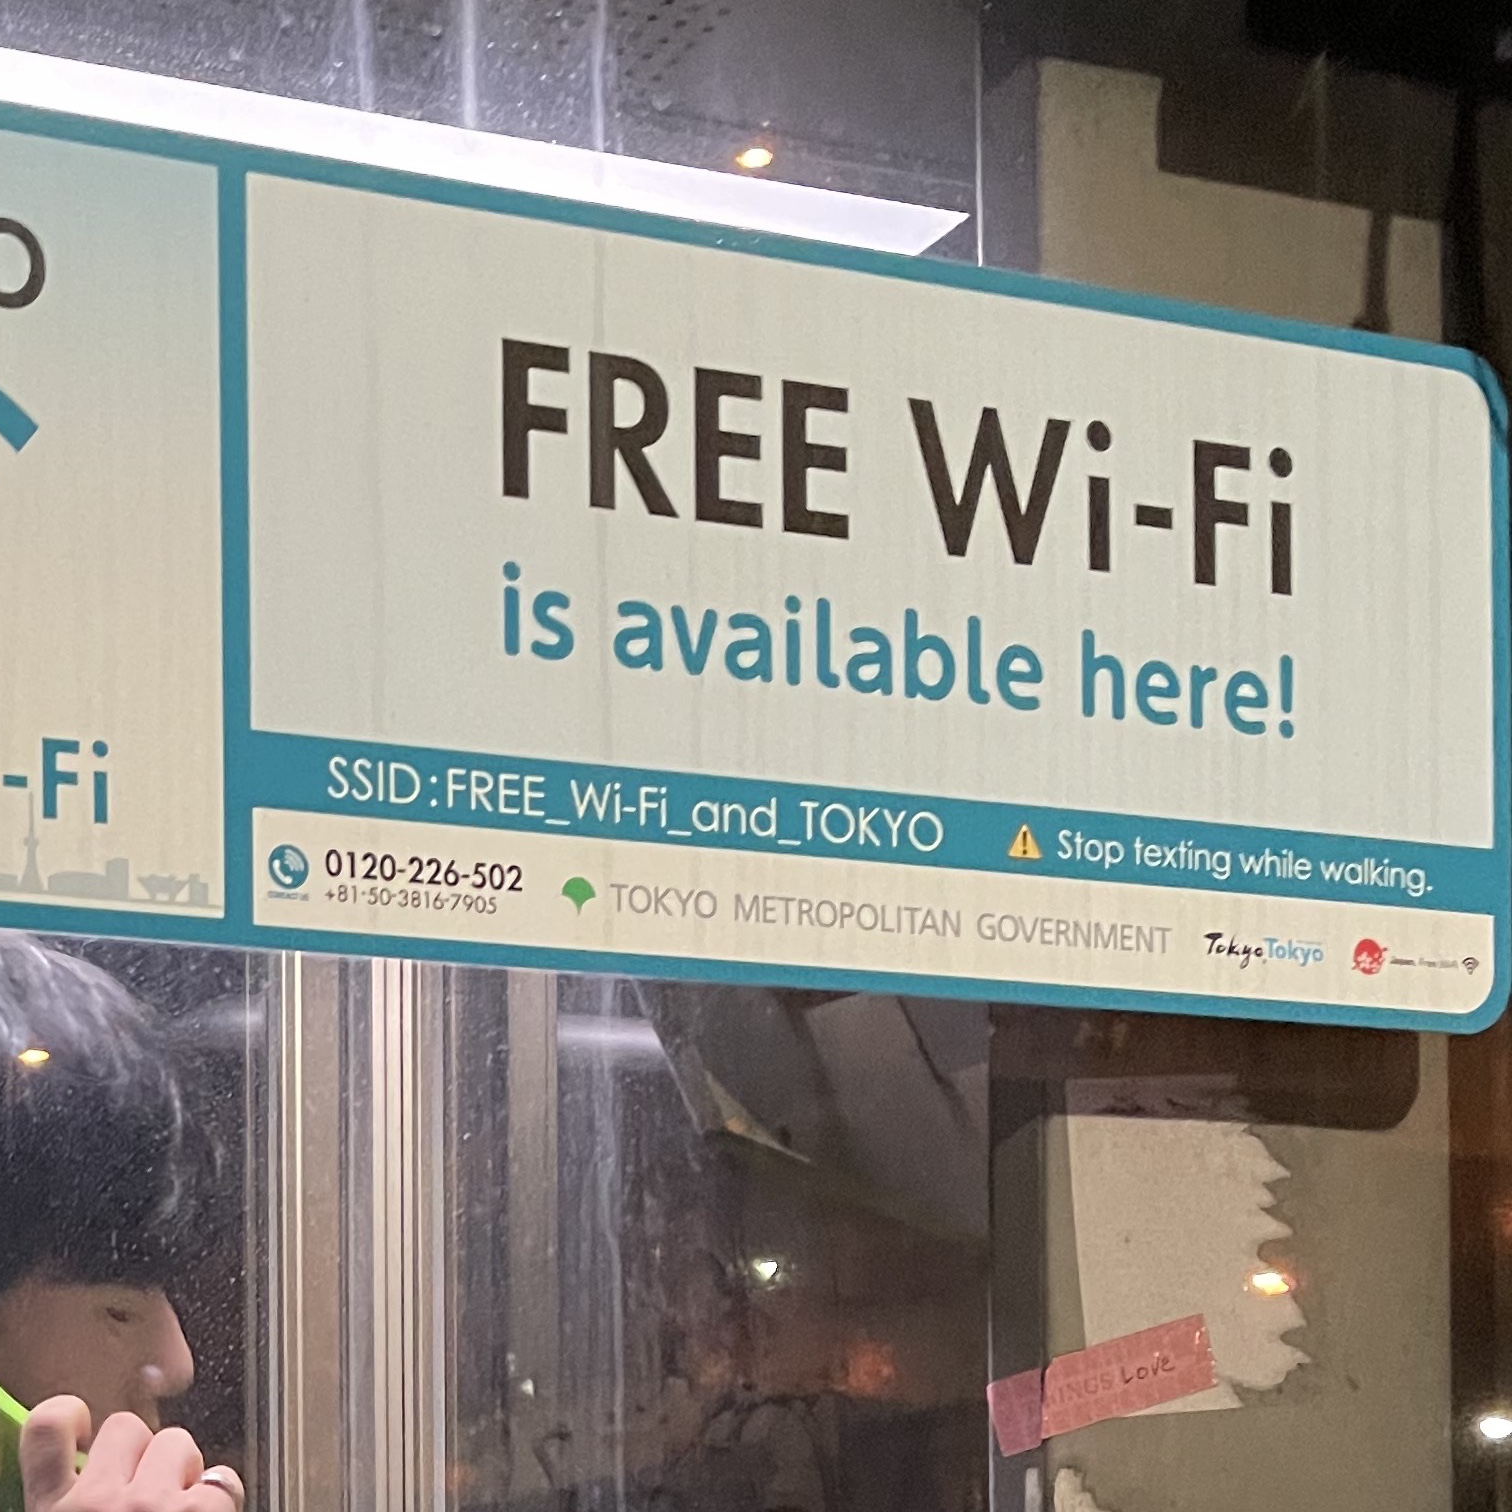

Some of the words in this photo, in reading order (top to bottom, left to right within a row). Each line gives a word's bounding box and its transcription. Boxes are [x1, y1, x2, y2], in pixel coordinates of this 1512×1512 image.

[500, 337, 851, 541] FREE
[909, 397, 1293, 597] Wi-Fi
[501, 560, 575, 660] is
[613, 595, 1044, 712] available
[1082, 630, 1296, 739] here!
[325, 848, 524, 893] 0120-226-502
[1057, 829, 1125, 869] Stop
[1134, 836, 1231, 880] texting
[1238, 847, 1312, 880] while
[1320, 858, 1434, 897] walking.
[324, 884, 498, 915] +81-50-3816-7905
[609, 883, 719, 919] TOKYO
[733, 893, 962, 938] METROPOLITAN
[976, 912, 1173, 954] GOVERNMENT
